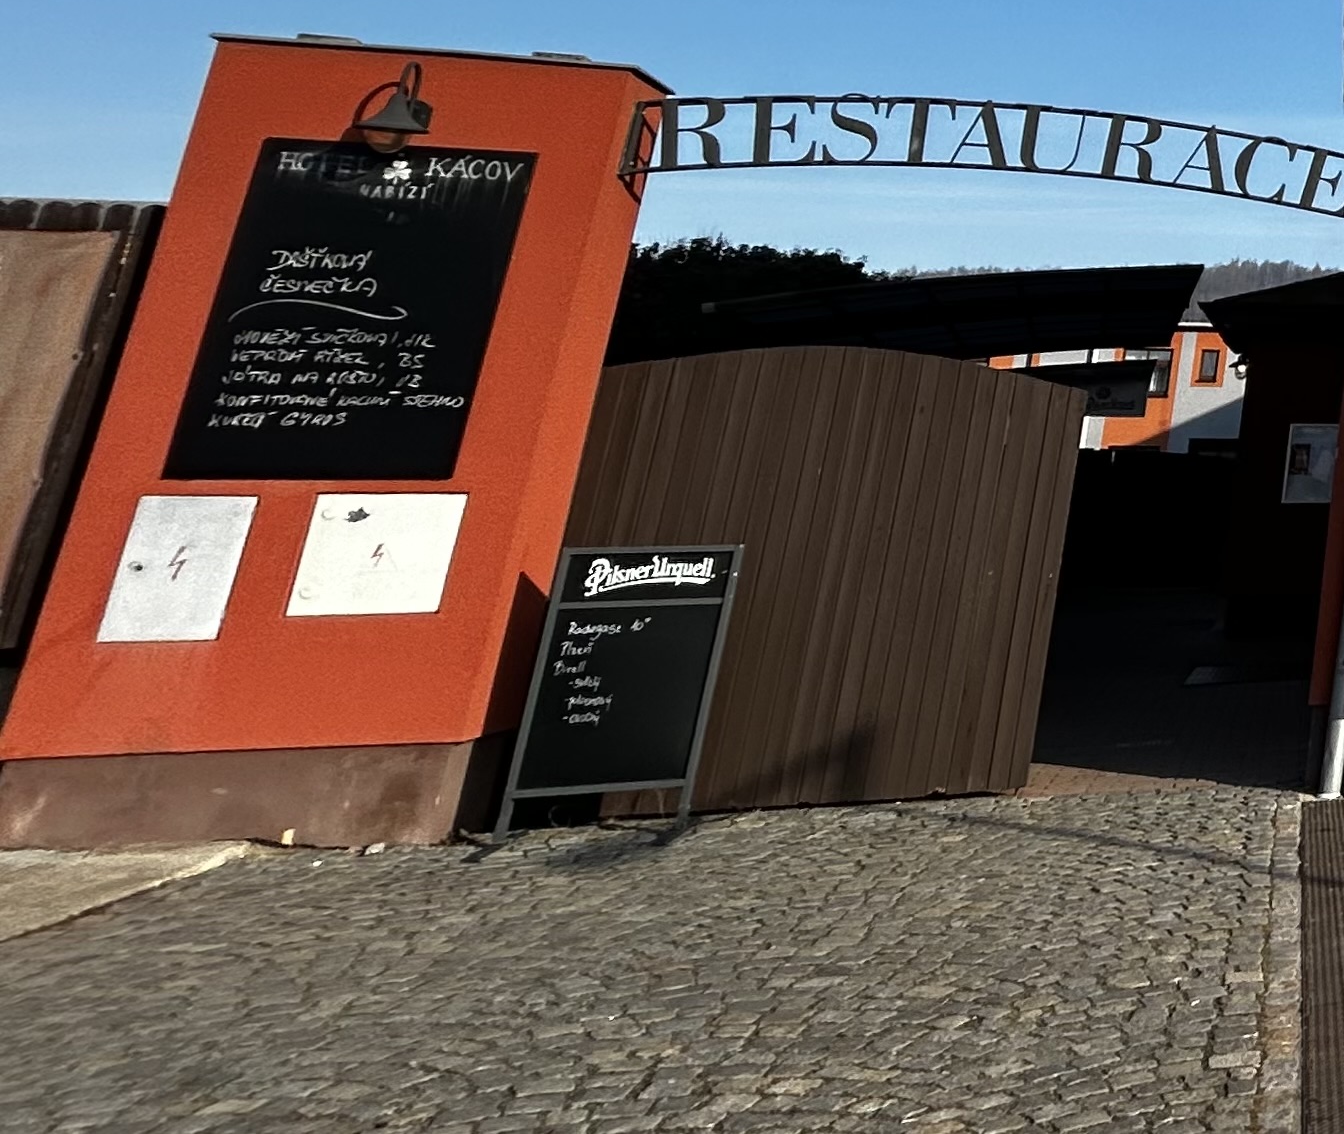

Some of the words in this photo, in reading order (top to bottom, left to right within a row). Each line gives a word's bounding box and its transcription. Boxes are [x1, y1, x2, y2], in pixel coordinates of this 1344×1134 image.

[424, 155, 524, 182] KÁCOV
[359, 181, 435, 200] NABÍZÍ
[291, 371, 319, 384] NA
[280, 412, 348, 427] GYROS
[584, 558, 655, 597] Pilsner
